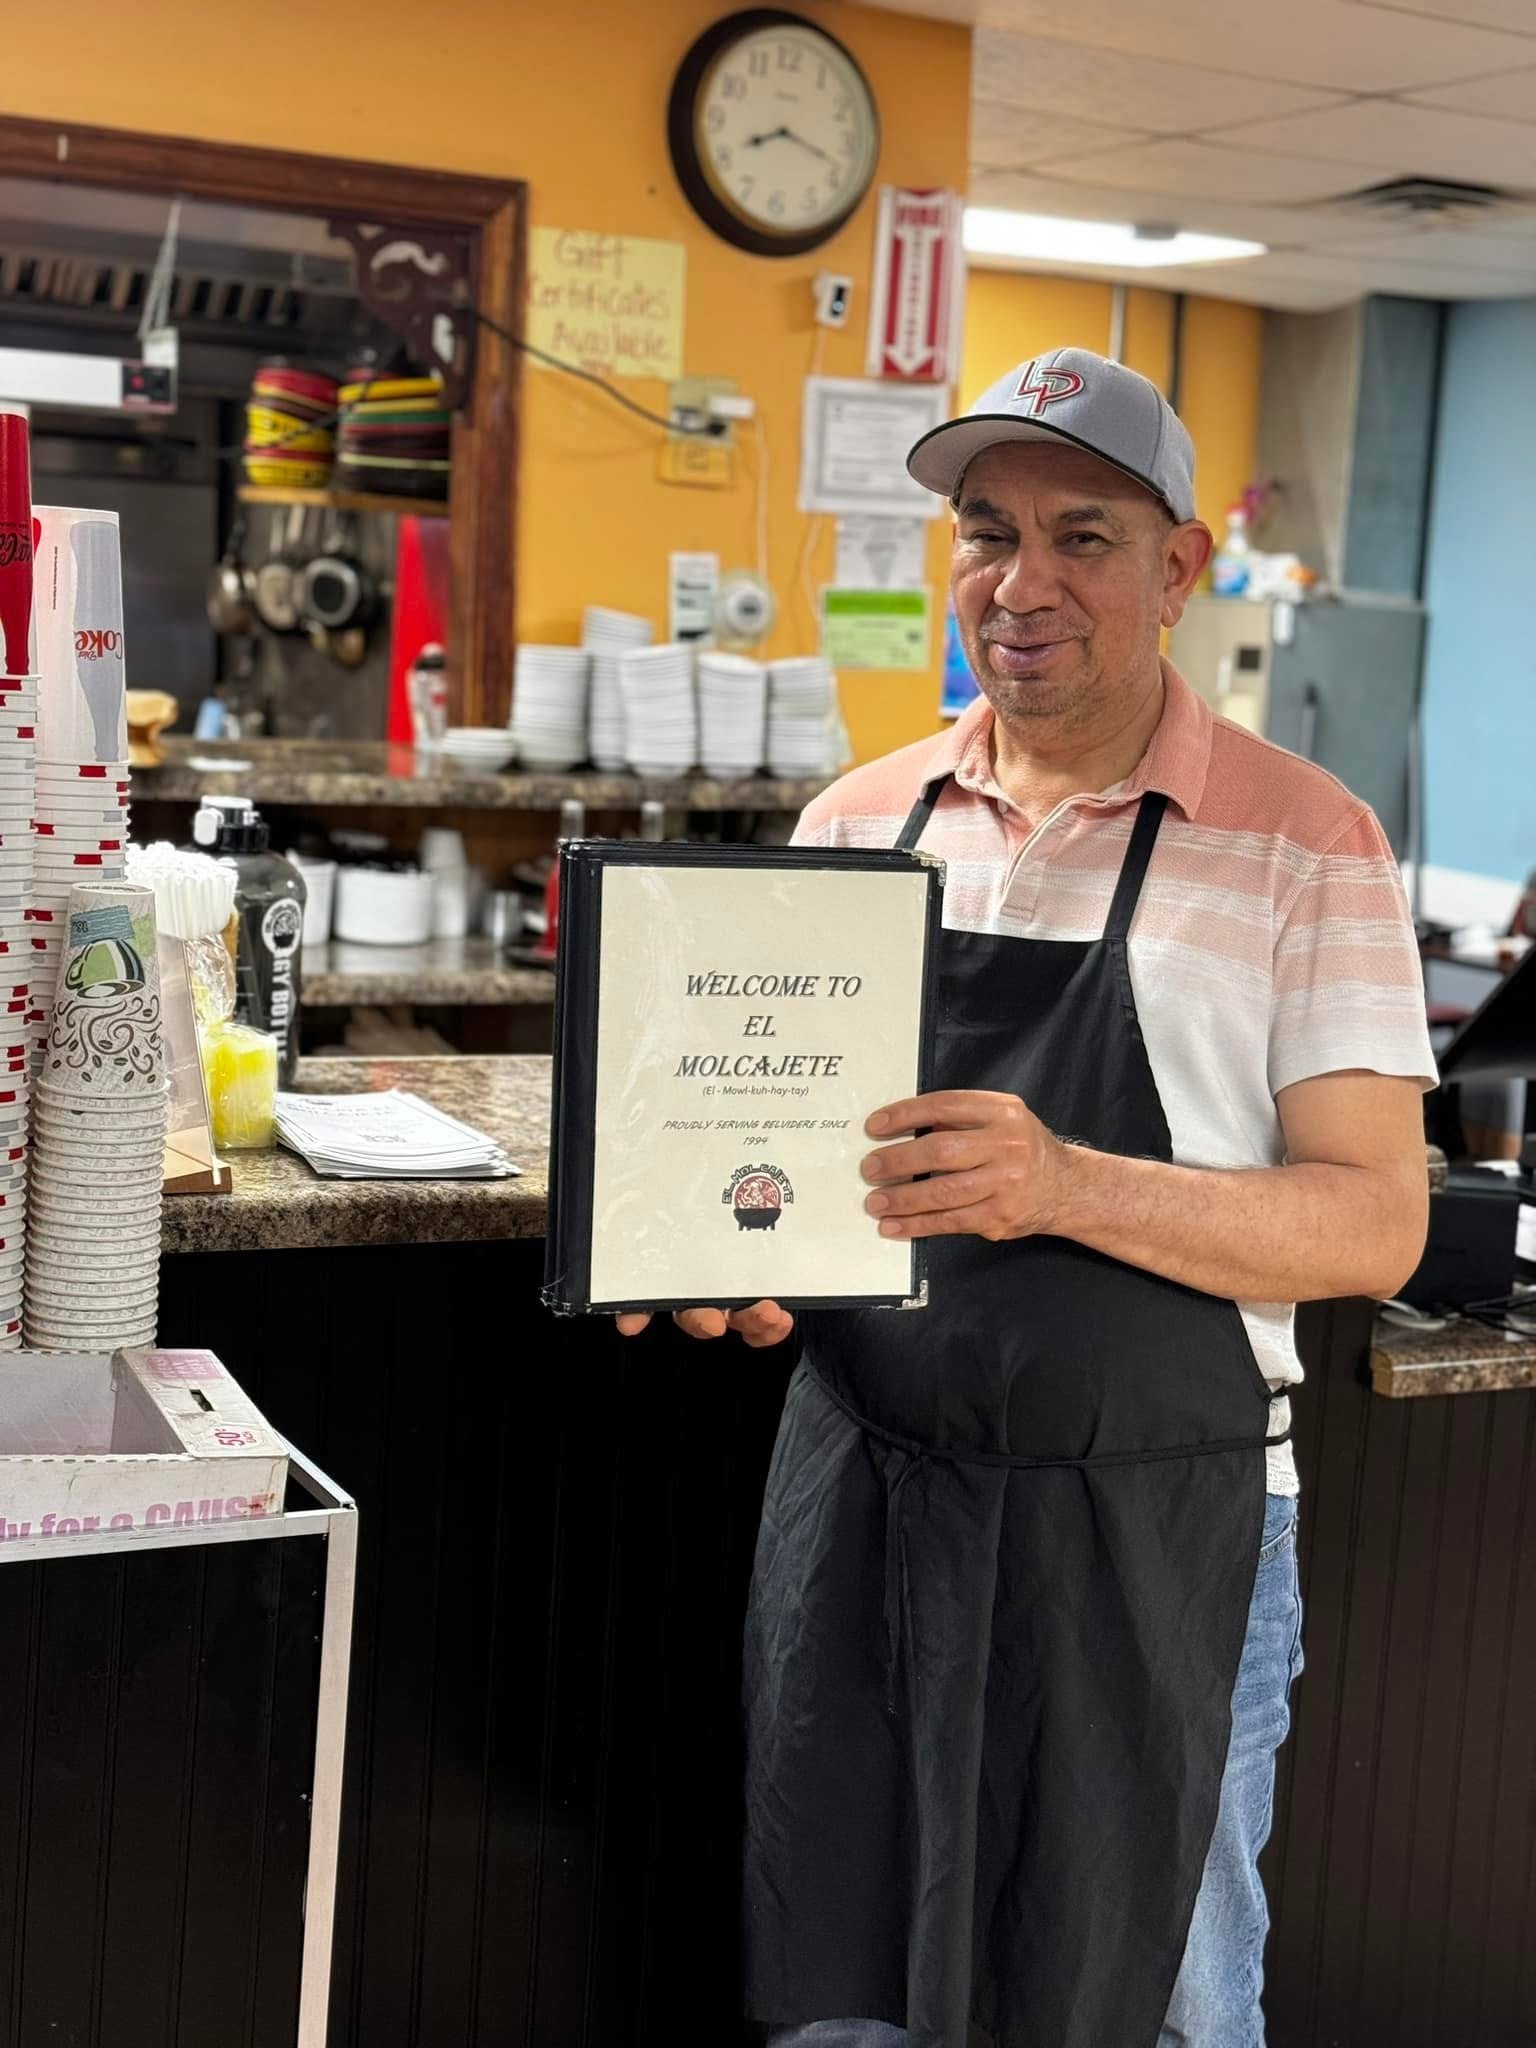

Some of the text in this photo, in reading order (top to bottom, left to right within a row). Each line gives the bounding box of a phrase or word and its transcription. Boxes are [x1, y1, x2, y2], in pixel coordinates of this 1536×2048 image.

[686, 970, 862, 998] WELCOME TO
[742, 1015, 777, 1038] EL
[674, 1055, 843, 1078] MOLCAJETE
[702, 1086, 716, 1096] (El
[722, 1085, 810, 1097] Mowl-kuh-hay-tay)
[662, 1119, 849, 1131] PROUDLY SERVING BELVIDERE SINCE
[743, 1136, 769, 1146] 1994
